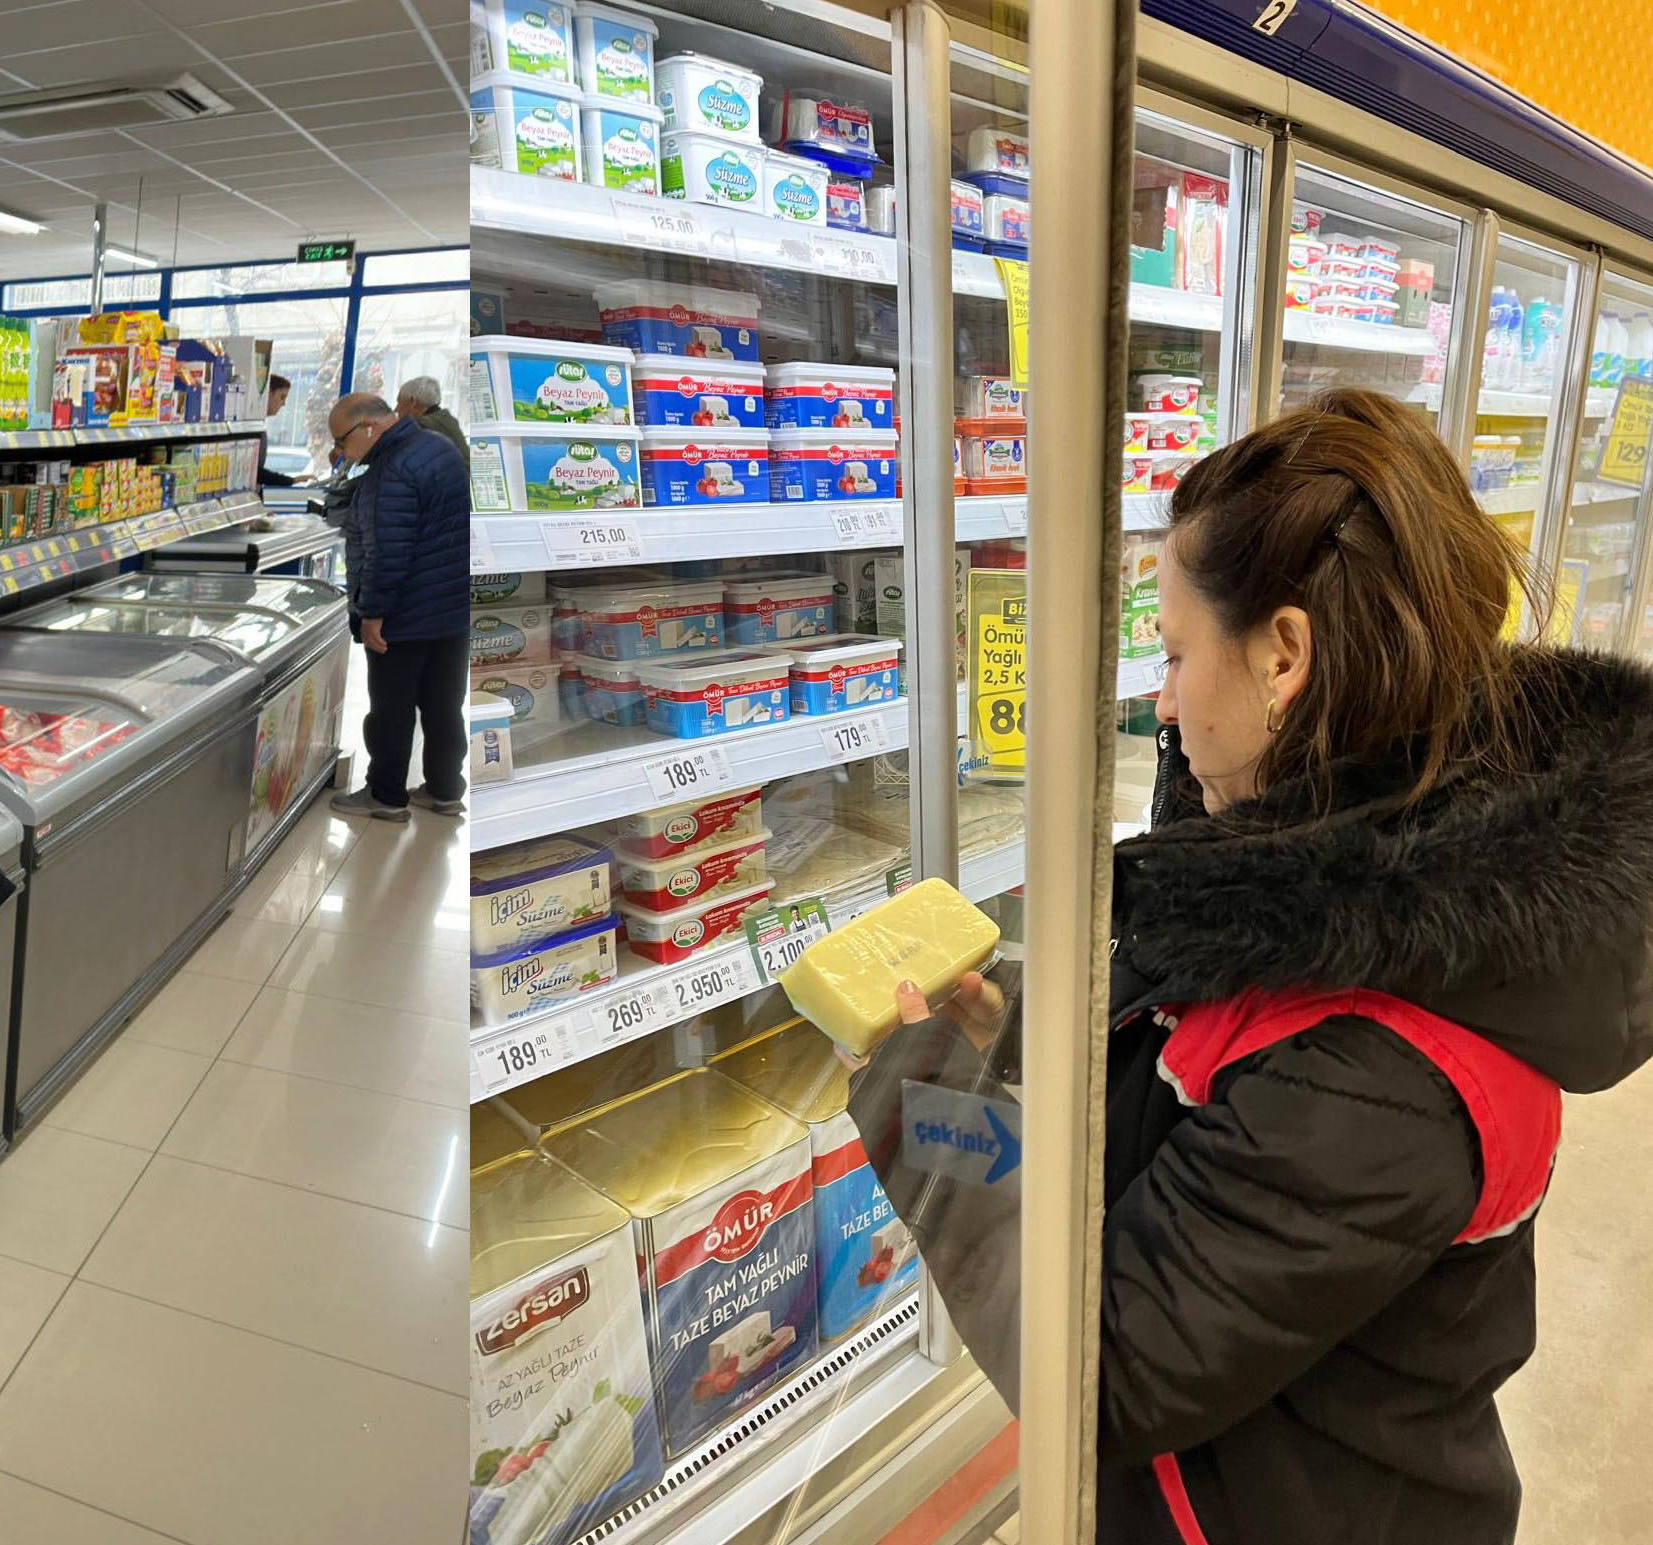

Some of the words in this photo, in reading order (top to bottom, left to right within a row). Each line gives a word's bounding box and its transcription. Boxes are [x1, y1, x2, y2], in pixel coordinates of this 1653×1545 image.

[1259, 1, 1286, 31] 2
[707, 95, 743, 116] Süzme
[714, 166, 750, 187] Süzme
[781, 186, 814, 206] Süzme
[669, 312, 690, 321] ÖMÜR
[543, 385, 574, 399] Beyaz
[576, 388, 604, 403] Peynir
[677, 382, 698, 392] ÖMÜR
[821, 387, 838, 397] ÖMÜR
[682, 449, 702, 459] ÖMÜR
[827, 450, 844, 460] ÖMÜR
[555, 467, 585, 480] Beyaz
[587, 467, 615, 481] Peynir
[580, 527, 626, 545] 215,00
[636, 612, 658, 621] ÖMÜR
[756, 604, 776, 612] ÖMÜR
[984, 624, 1026, 645] Ömü
[983, 648, 1022, 668] Yağlı
[827, 670, 847, 680] ÖMÜR
[984, 669, 1009, 686] 2,5
[702, 690, 725, 699] ÖMÜR
[863, 734, 872, 744] TL
[698, 767, 710, 777] TL
[958, 754, 990, 775] çekiniz
[671, 820, 692, 833] Ekici
[674, 874, 694, 886] Ekici
[490, 888, 531, 926] İçim
[516, 904, 565, 927] Süzme
[678, 926, 698, 938] Ekici
[501, 957, 542, 996] İçim
[526, 971, 574, 995] Süzme
[725, 977, 736, 987] TL
[646, 1005, 657, 1017] TL
[540, 1048, 552, 1059] TL
[914, 1118, 996, 1156] çekiniz
[704, 1201, 774, 1253] ÖMÜR
[840, 1210, 872, 1240] TAZE
[704, 1274, 737, 1305] TAM
[738, 1247, 779, 1286] YAĞLI
[486, 1277, 582, 1342] zersan
[670, 1315, 711, 1351] TAZE
[712, 1285, 759, 1328] BEYAZ
[761, 1252, 809, 1299] PEYNİR
[498, 1373, 514, 1391] AZ
[515, 1353, 552, 1381] YAĞLI
[553, 1334, 586, 1359] TAZE
[486, 1380, 545, 1419] Beyaz
[549, 1345, 599, 1383] Peynir
